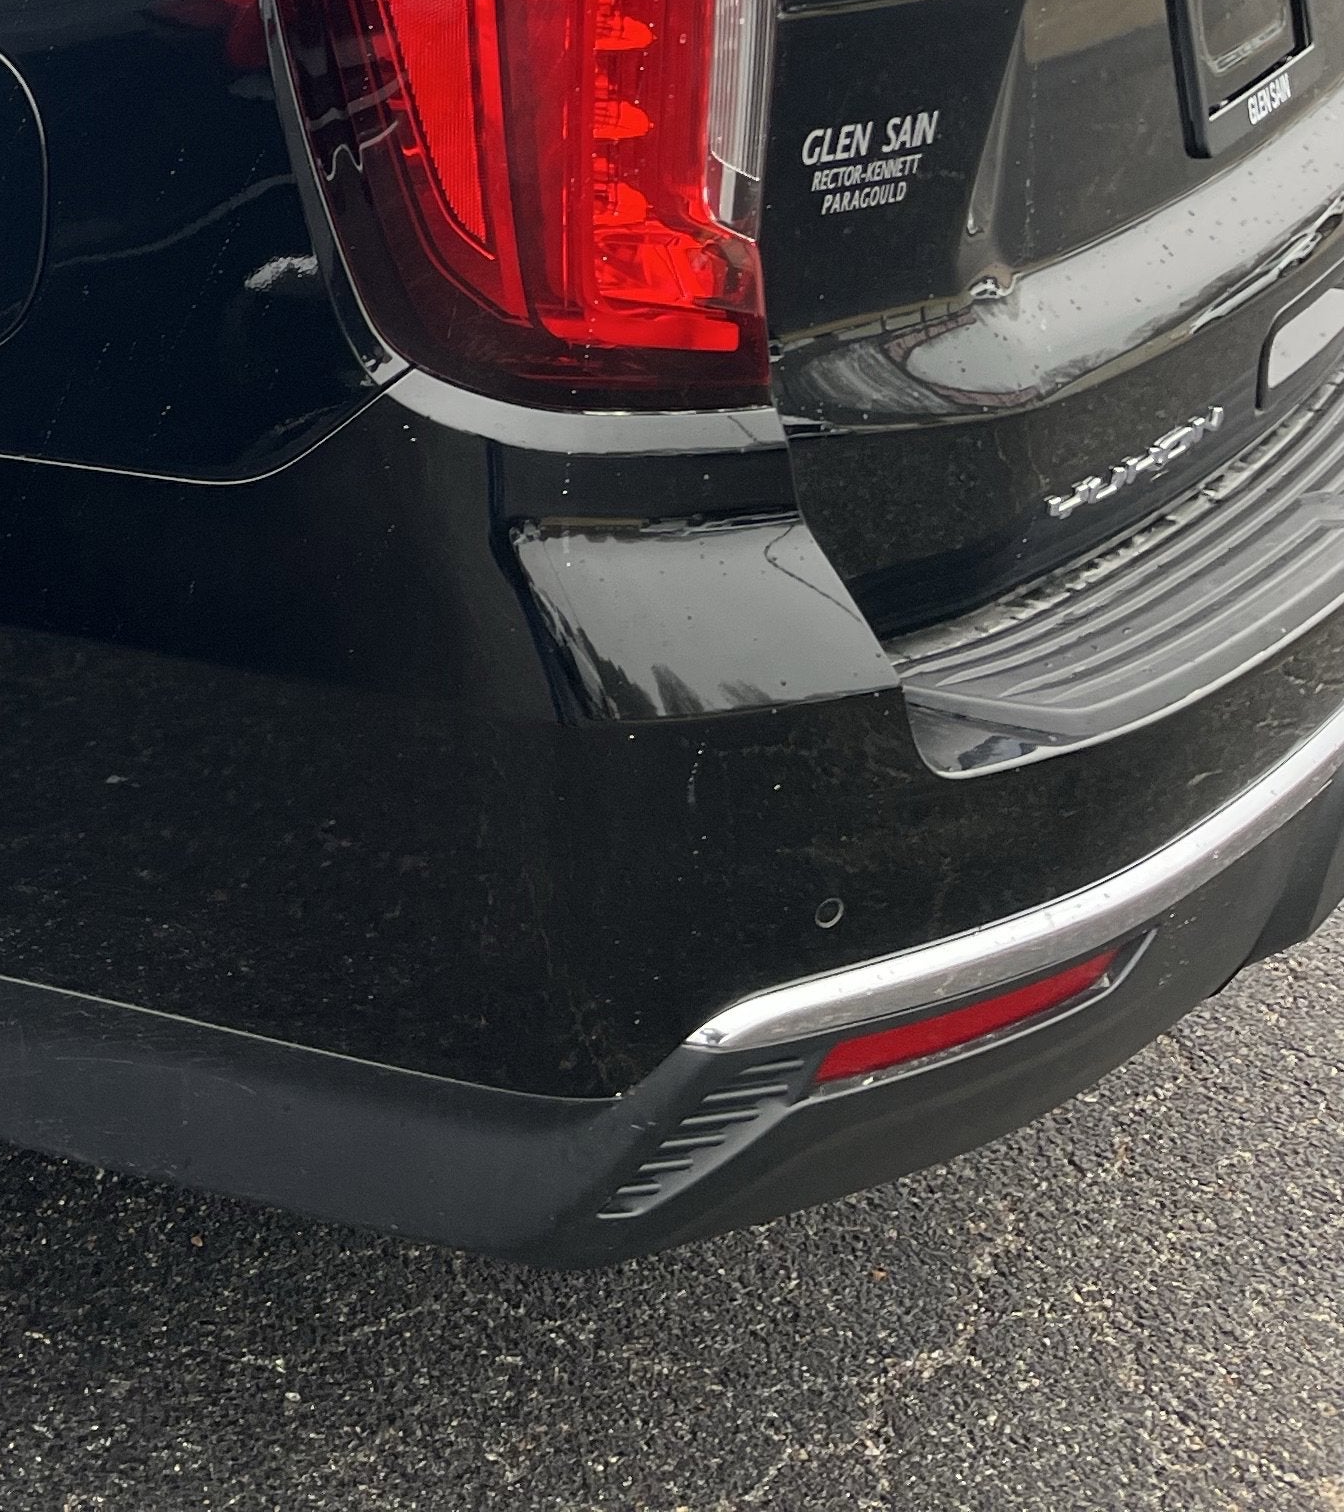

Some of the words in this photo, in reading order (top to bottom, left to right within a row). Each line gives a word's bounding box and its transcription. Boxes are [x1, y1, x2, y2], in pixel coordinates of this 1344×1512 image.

[801, 120, 874, 166] GLEN
[881, 110, 940, 153] SAIN
[811, 154, 923, 192] RECTOR-KENNETT
[820, 181, 908, 215] PARAGOULD
[1043, 405, 1224, 520] YUKON
